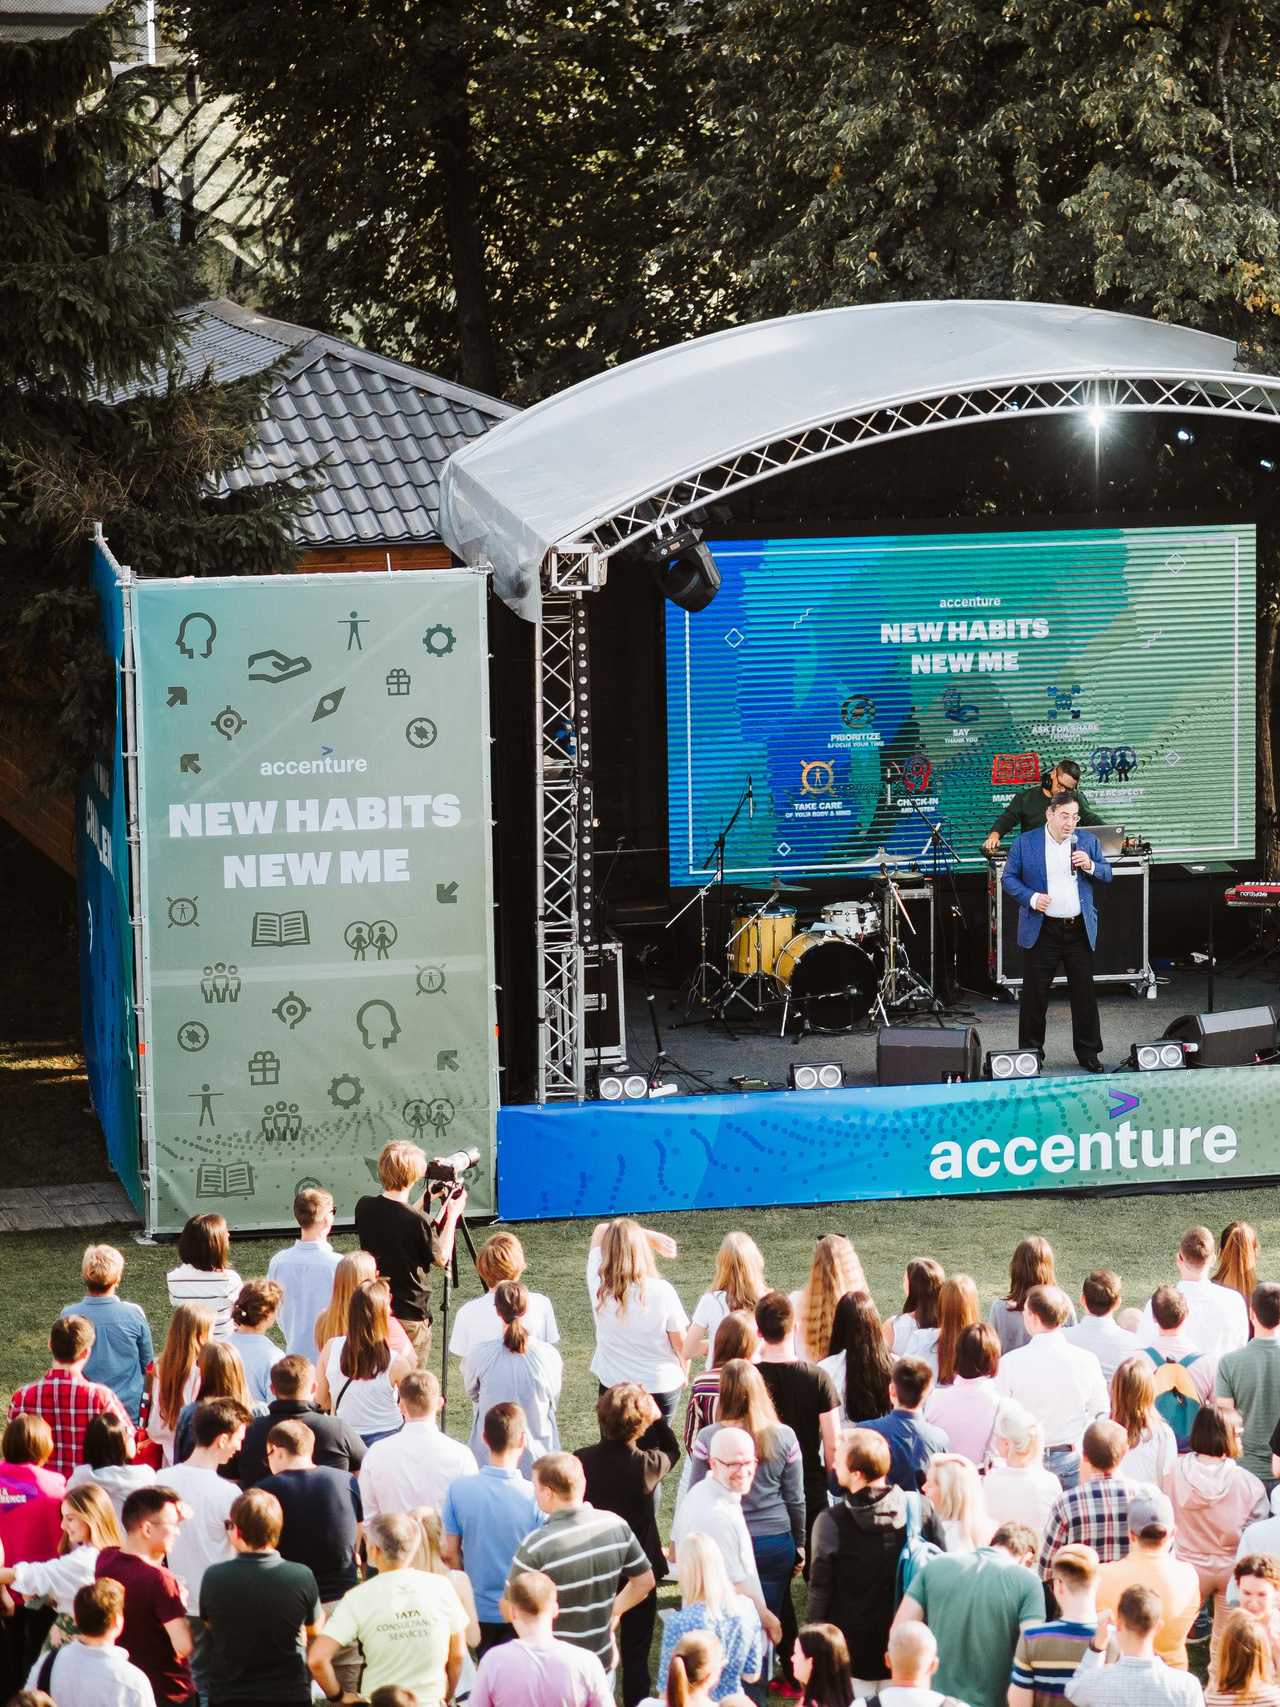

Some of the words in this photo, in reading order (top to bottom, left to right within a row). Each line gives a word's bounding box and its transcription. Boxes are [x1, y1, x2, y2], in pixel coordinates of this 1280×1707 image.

[939, 596, 1001, 608] accenture
[880, 622, 944, 644] NEW
[947, 618, 1050, 641] HABITS
[911, 652, 974, 675] NEW
[978, 651, 1019, 672] ME
[830, 733, 881, 742] PRIORITIZE
[953, 728, 970, 737] SAY
[260, 756, 368, 776] accenture
[794, 803, 817, 811] TAKE
[818, 801, 843, 810] CARE
[169, 800, 278, 838] NEW
[285, 793, 461, 833] HABITS
[223, 851, 333, 889] NEW
[339, 848, 411, 884] ME
[929, 1120, 1237, 1180] accenture
[394, 1609, 421, 1620] TATA
[388, 1629, 429, 1641] SERVICES
